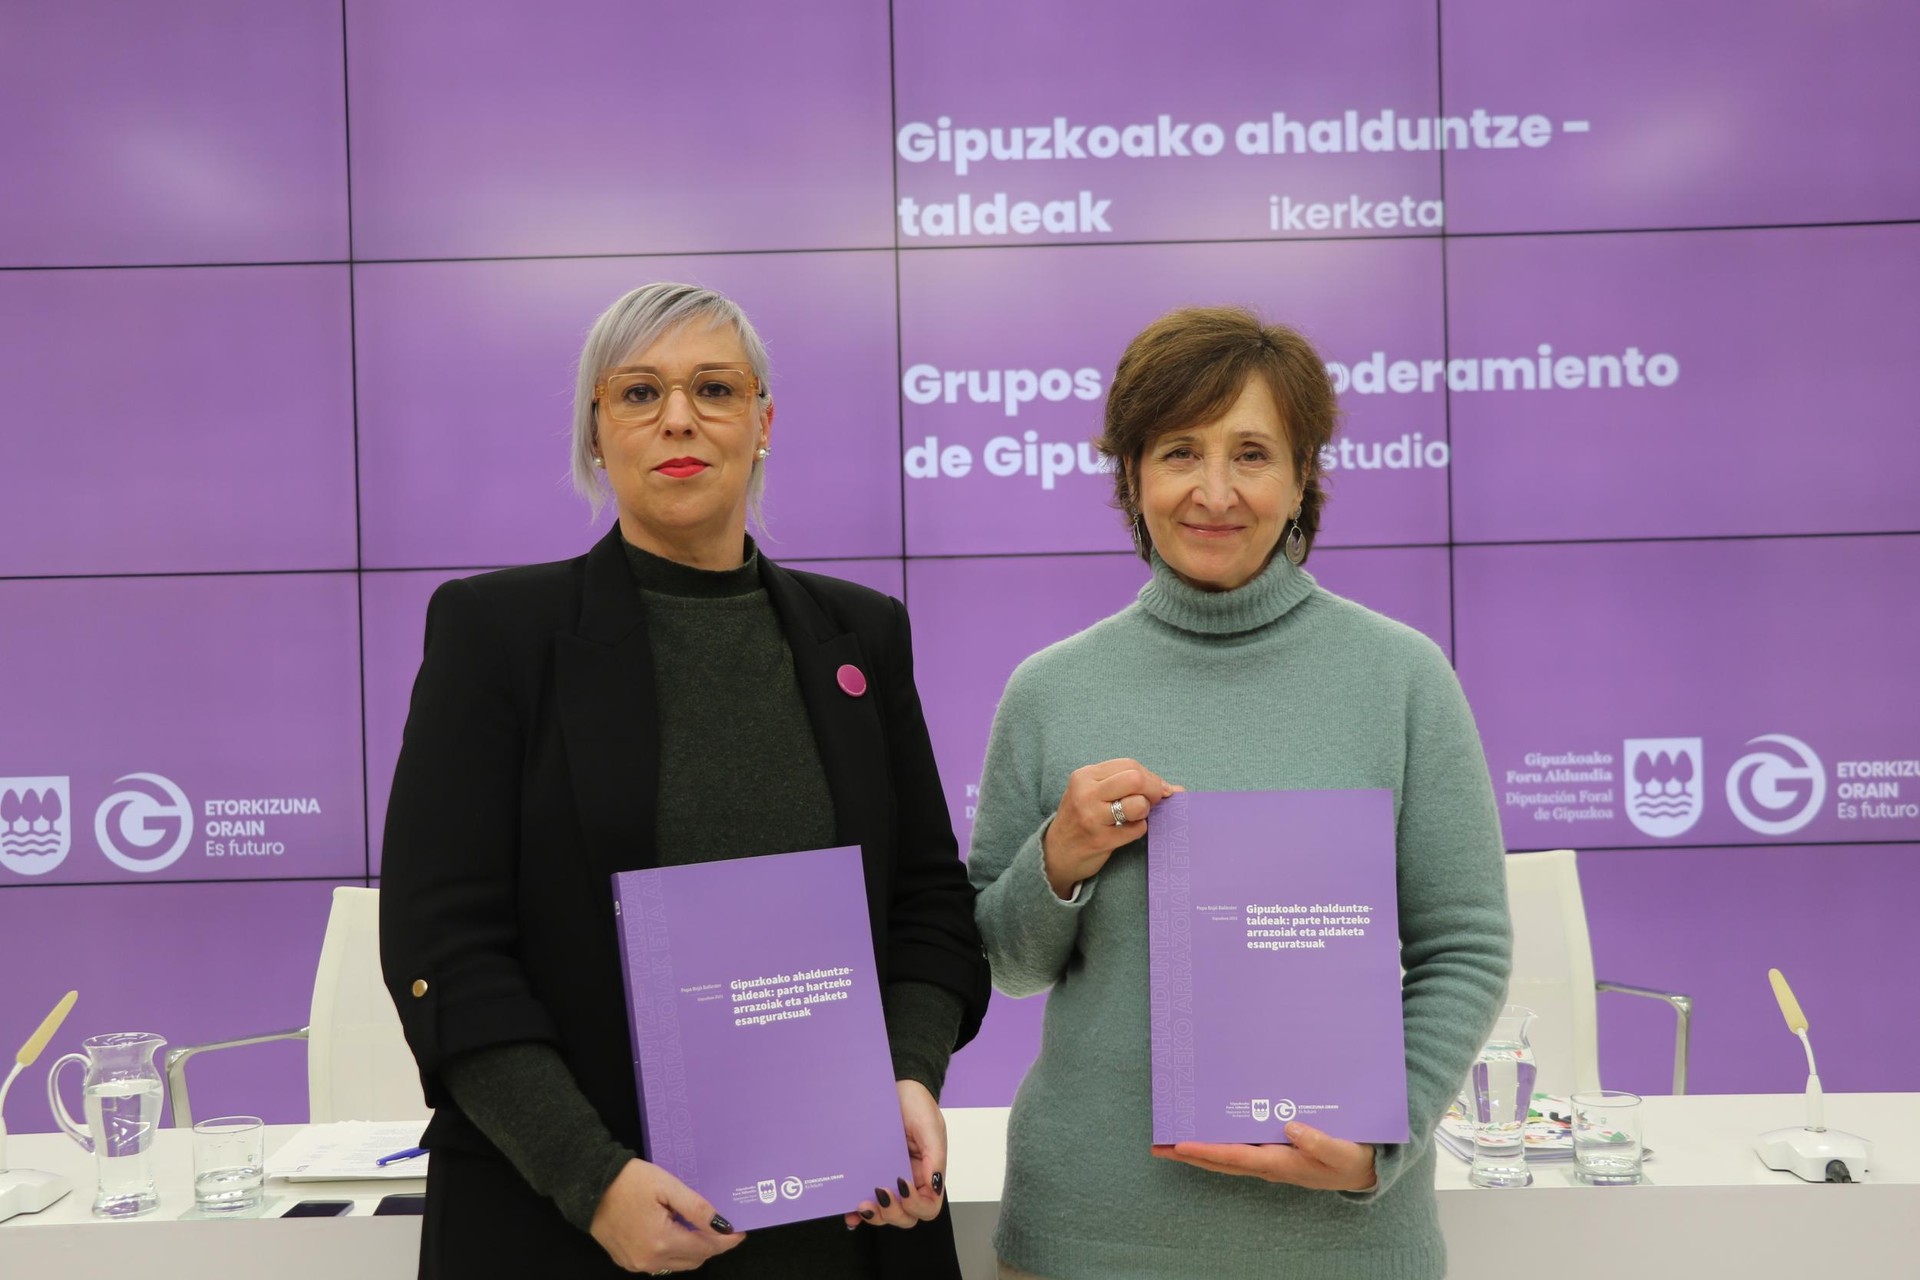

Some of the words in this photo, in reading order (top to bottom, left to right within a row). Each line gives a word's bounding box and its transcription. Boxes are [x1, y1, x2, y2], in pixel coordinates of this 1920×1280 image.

[897, 114, 1225, 176] Gipuzkoako
[1234, 110, 1552, 156] ahalduntze
[897, 190, 1112, 237] taldeak
[1269, 194, 1443, 232] ikerketa
[902, 363, 1103, 416] Grupos
[1326, 343, 1680, 394] oderamiento
[904, 437, 973, 479] de
[984, 430, 1114, 490] Gipu
[1318, 433, 1449, 471] studio
[1524, 751, 1613, 768] Gipuzkoako
[1506, 770, 1542, 784] Foru
[1544, 767, 1613, 783] Aldundia
[1506, 789, 1576, 807] Diputación
[1578, 788, 1613, 803] Foral
[1838, 782, 1899, 799] ORAIN
[204, 798, 322, 816] ETORKIZUNA
[1534, 806, 1550, 821] de
[1552, 805, 1613, 823] Gipuzkoa
[1838, 802, 1857, 819] Es
[1861, 801, 1919, 819] futuro
[205, 820, 265, 837] ORAIN
[205, 840, 225, 857] Es
[229, 839, 285, 856] futuro
[1246, 904, 1307, 915] Gipuzkoako
[1309, 903, 1373, 914] ahalduntze-
[1246, 915, 1290, 926] taldeak:
[1292, 915, 1321, 926] parte
[1322, 915, 1371, 925] hartzeko
[1246, 927, 1298, 937] arrazoiak
[1299, 928, 1317, 937] eta
[1318, 926, 1365, 937] aldaketa
[1246, 938, 1326, 950] esanguratsuak
[730, 974, 791, 990] Gipuzkoako
[792, 967, 854, 982] ahalduntze-
[732, 988, 775, 1002] taldeak:
[777, 984, 805, 996] parte
[806, 978, 852, 992] hartzeko
[734, 998, 783, 1014] arrazoiak
[785, 997, 802, 1008] eta
[803, 991, 848, 1005] aldaketa
[735, 1007, 812, 1026] esanguratsuak
